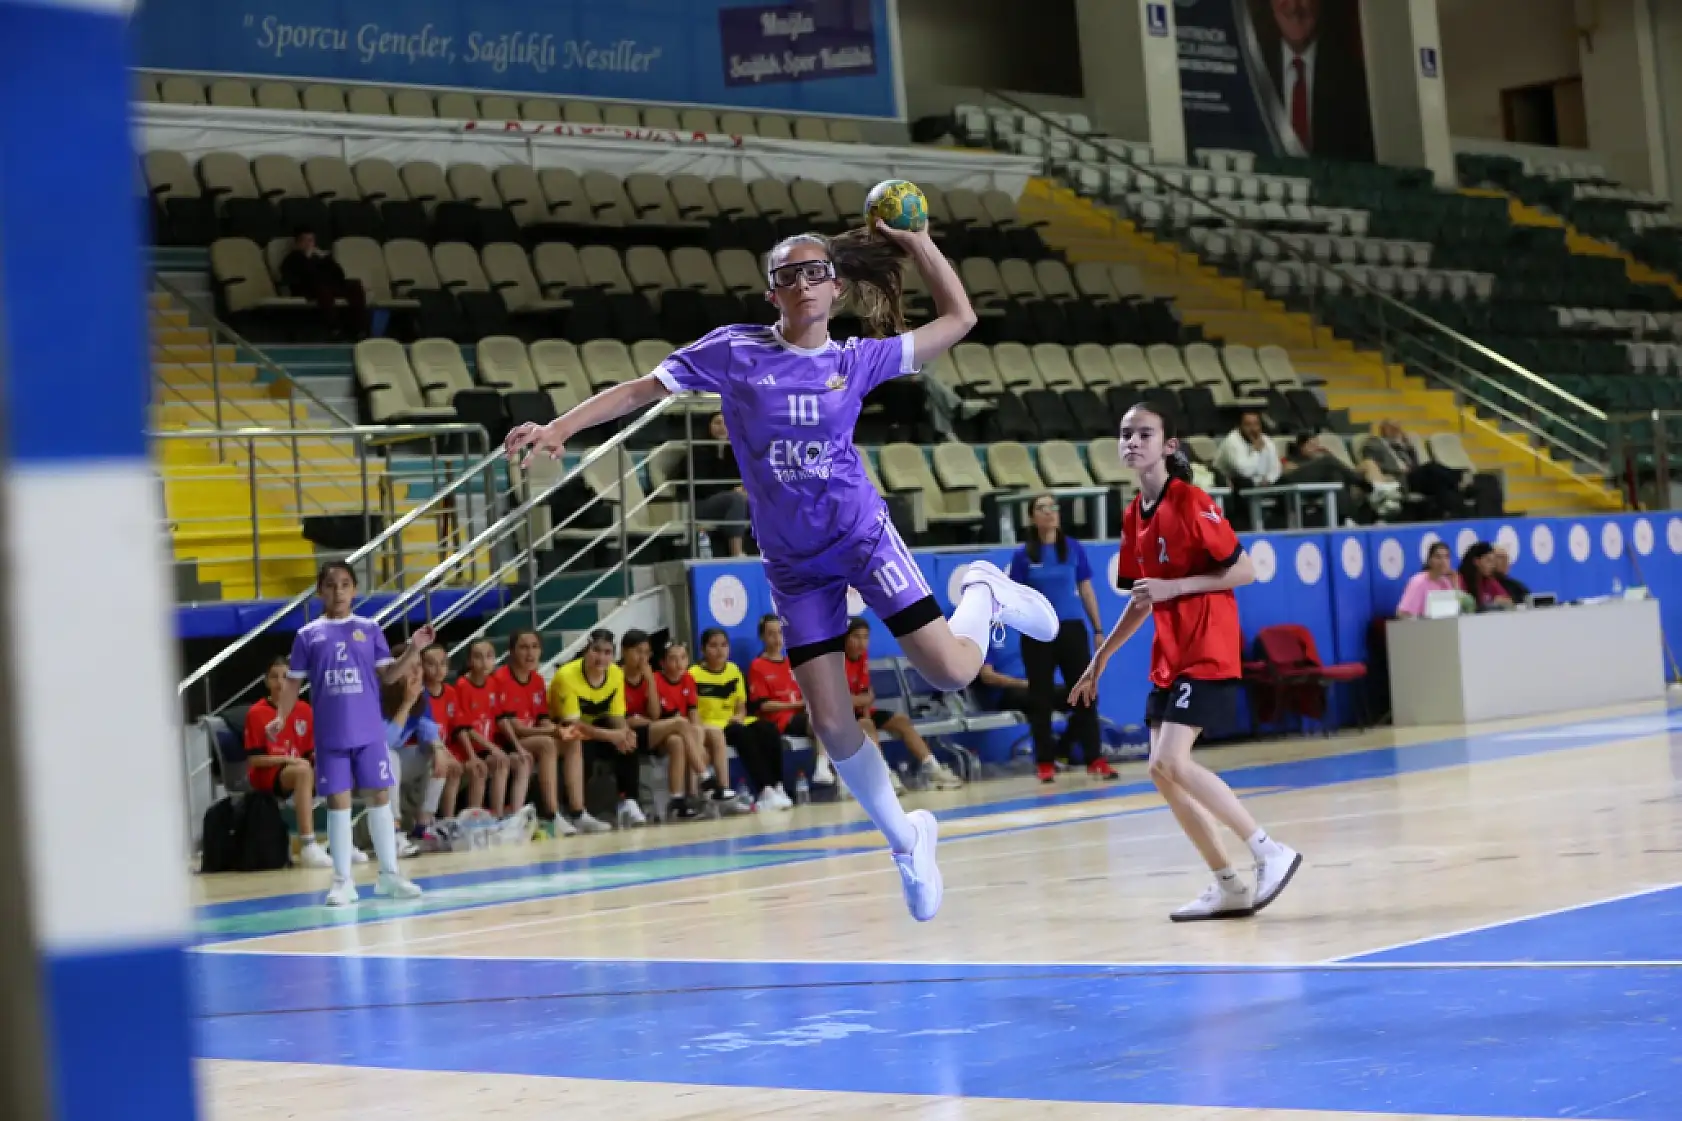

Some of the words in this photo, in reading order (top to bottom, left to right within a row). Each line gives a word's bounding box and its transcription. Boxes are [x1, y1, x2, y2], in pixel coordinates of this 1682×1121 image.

[357, 23, 456, 64] Gençler,
[463, 31, 555, 73] Sağlıklı
[788, 395, 819, 425] 10
[769, 440, 832, 467] EKOL
[1158, 537, 1169, 564] 2
[872, 560, 910, 598] 10
[335, 641, 348, 661] 2
[325, 667, 362, 686] EKOL
[1175, 683, 1191, 708] 2
[379, 761, 390, 780] 2
